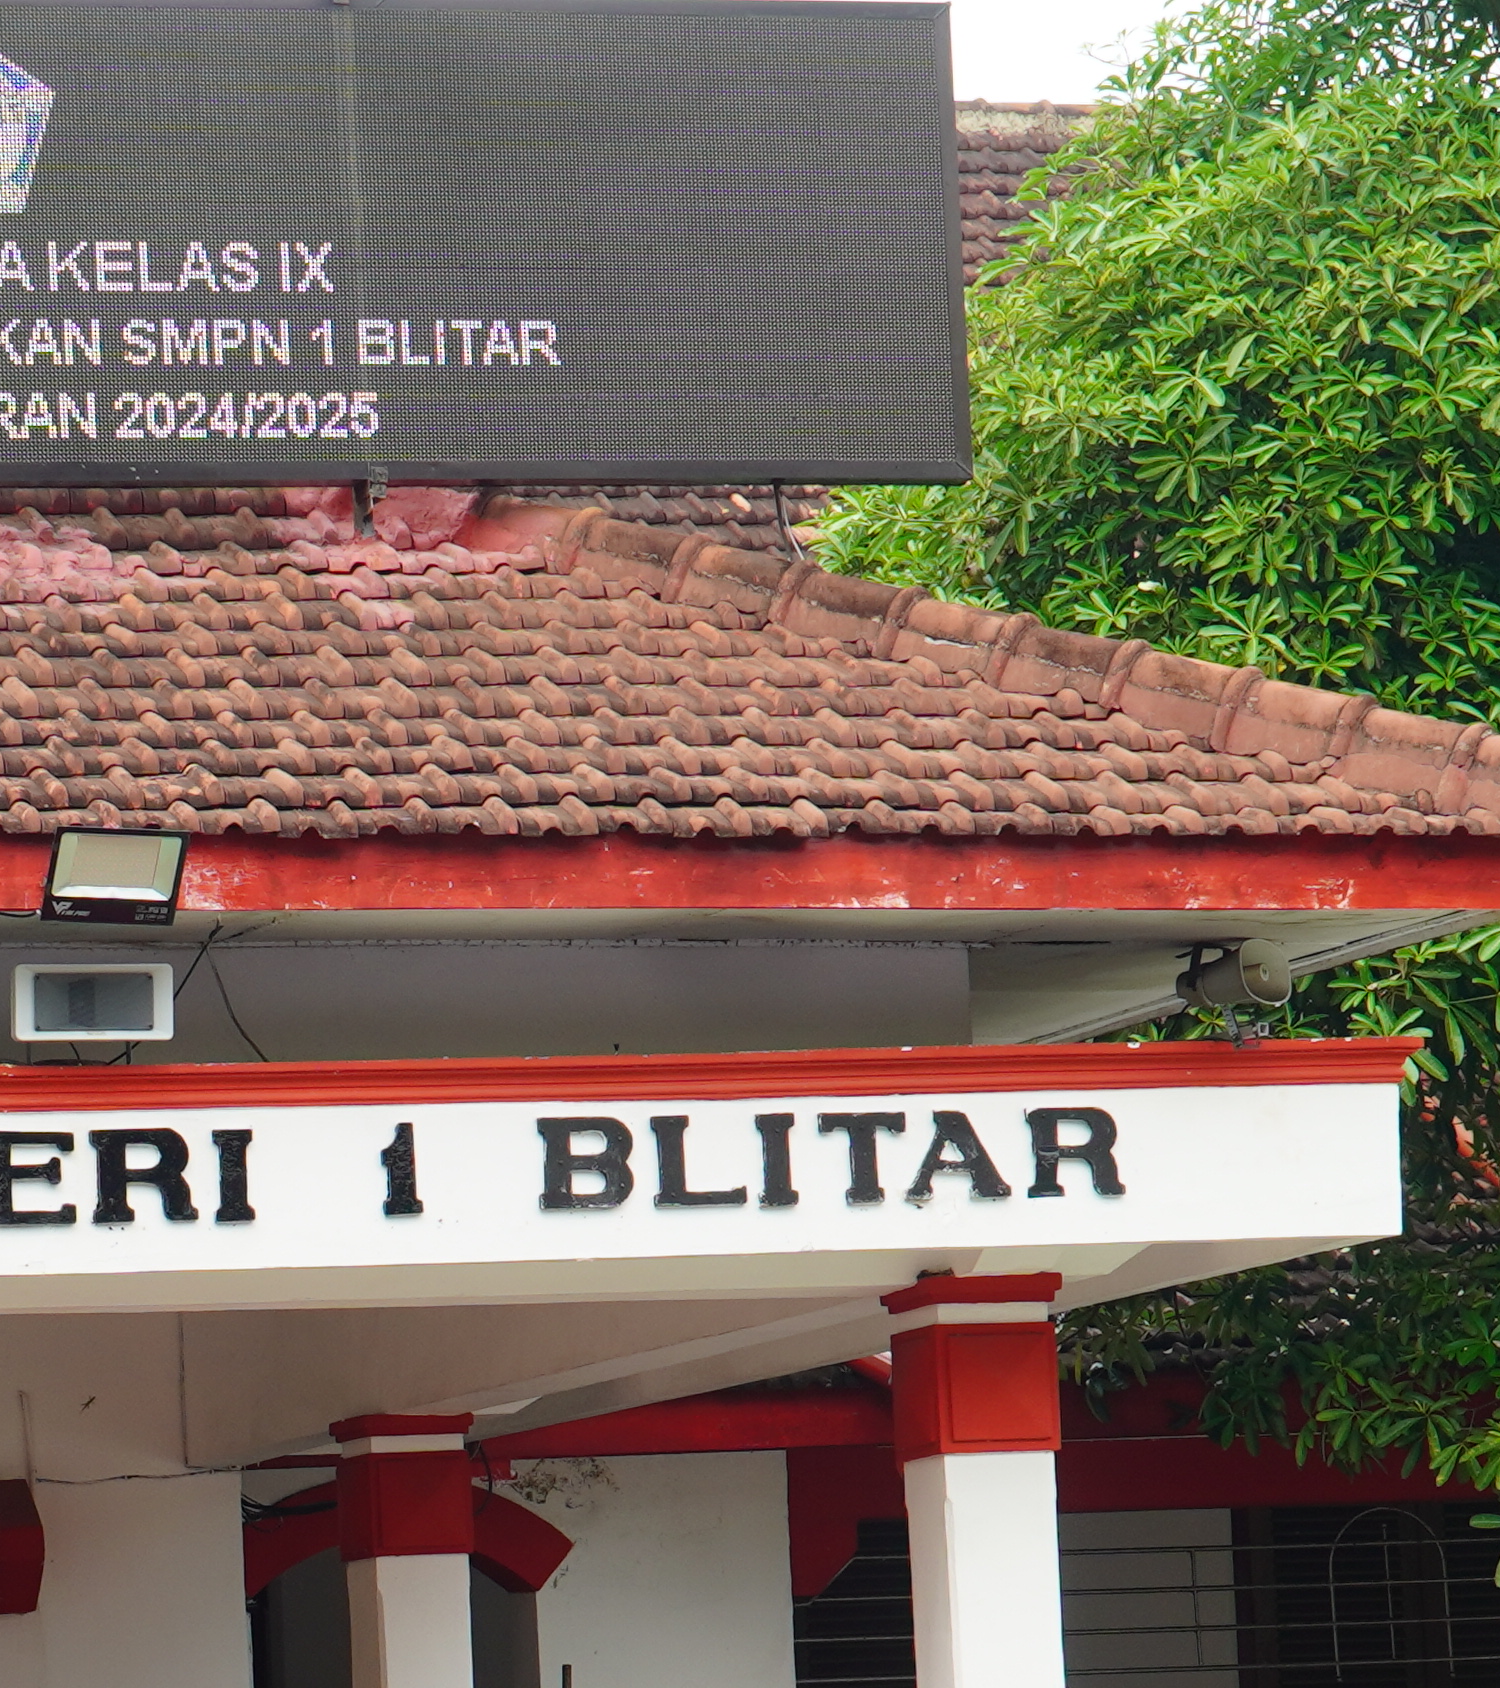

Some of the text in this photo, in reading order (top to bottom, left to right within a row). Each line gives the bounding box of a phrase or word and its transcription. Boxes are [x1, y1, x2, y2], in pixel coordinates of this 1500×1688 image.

[49, 239, 260, 293] KELAS
[278, 240, 335, 293] IX
[120, 317, 291, 366] SMPN
[310, 318, 334, 366] 1
[355, 317, 561, 367] BLITAR
[113, 390, 380, 441] 2024/2025
[381, 1121, 425, 1217] 1
[537, 1105, 1127, 1212] BLITAR
